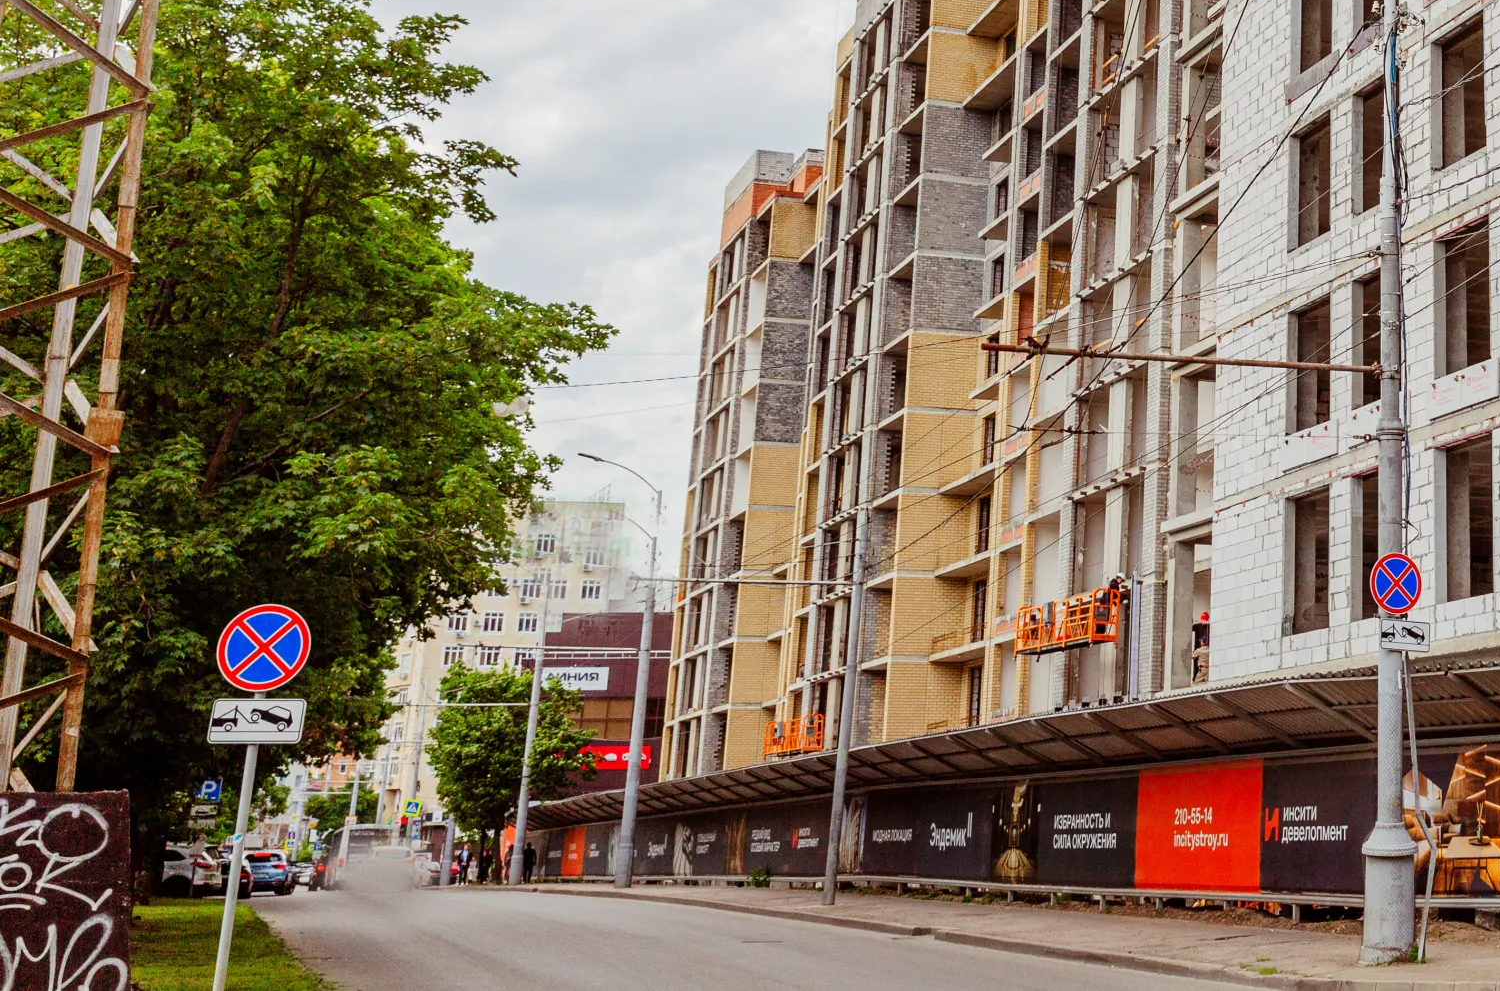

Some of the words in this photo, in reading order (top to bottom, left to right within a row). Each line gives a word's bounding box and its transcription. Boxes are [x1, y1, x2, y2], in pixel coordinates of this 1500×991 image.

[1053, 813, 1104, 830] ИЗБРАННОСТЬ
[1174, 807, 1213, 825] 210-55-14
[929, 822, 966, 851] Эндемик
[1053, 833, 1072, 849] СИЛА
[1072, 832, 1117, 849] ОКРУЖЕНИЯ
[1173, 830, 1229, 851] incitystroy.ru
[1281, 824, 1349, 844] девелопмент
